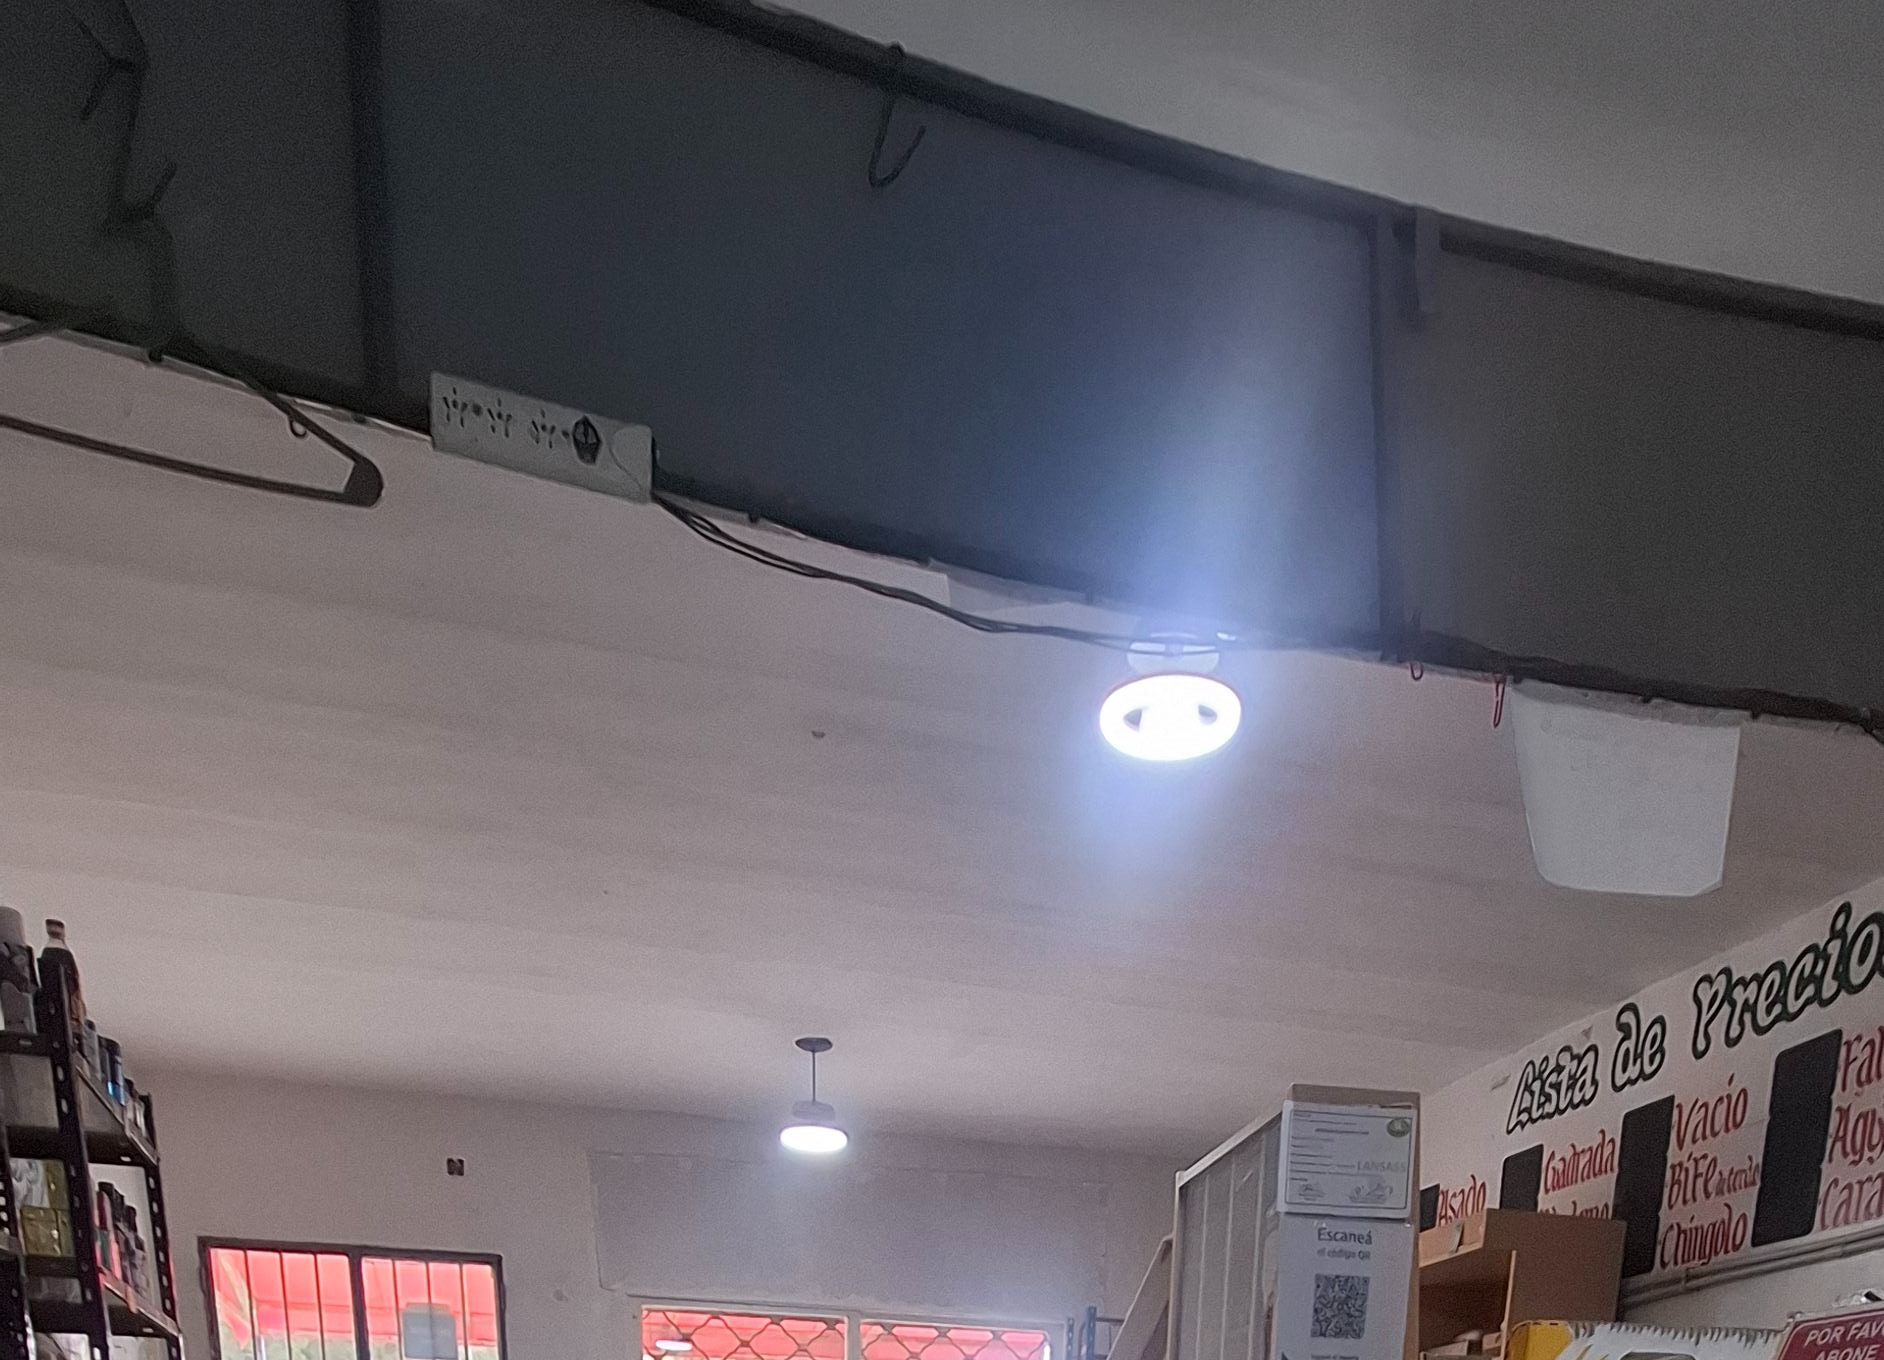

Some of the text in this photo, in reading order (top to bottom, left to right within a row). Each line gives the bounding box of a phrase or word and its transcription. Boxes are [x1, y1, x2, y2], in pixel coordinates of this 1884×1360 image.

[1506, 901, 1884, 1134] Lista de Precio
[1438, 1174, 1487, 1225] Asado
[1317, 1226, 1373, 1245] Escaneá
[1660, 1203, 1747, 1270] Chingolo
[1803, 1321, 1884, 1348] POR FAV
